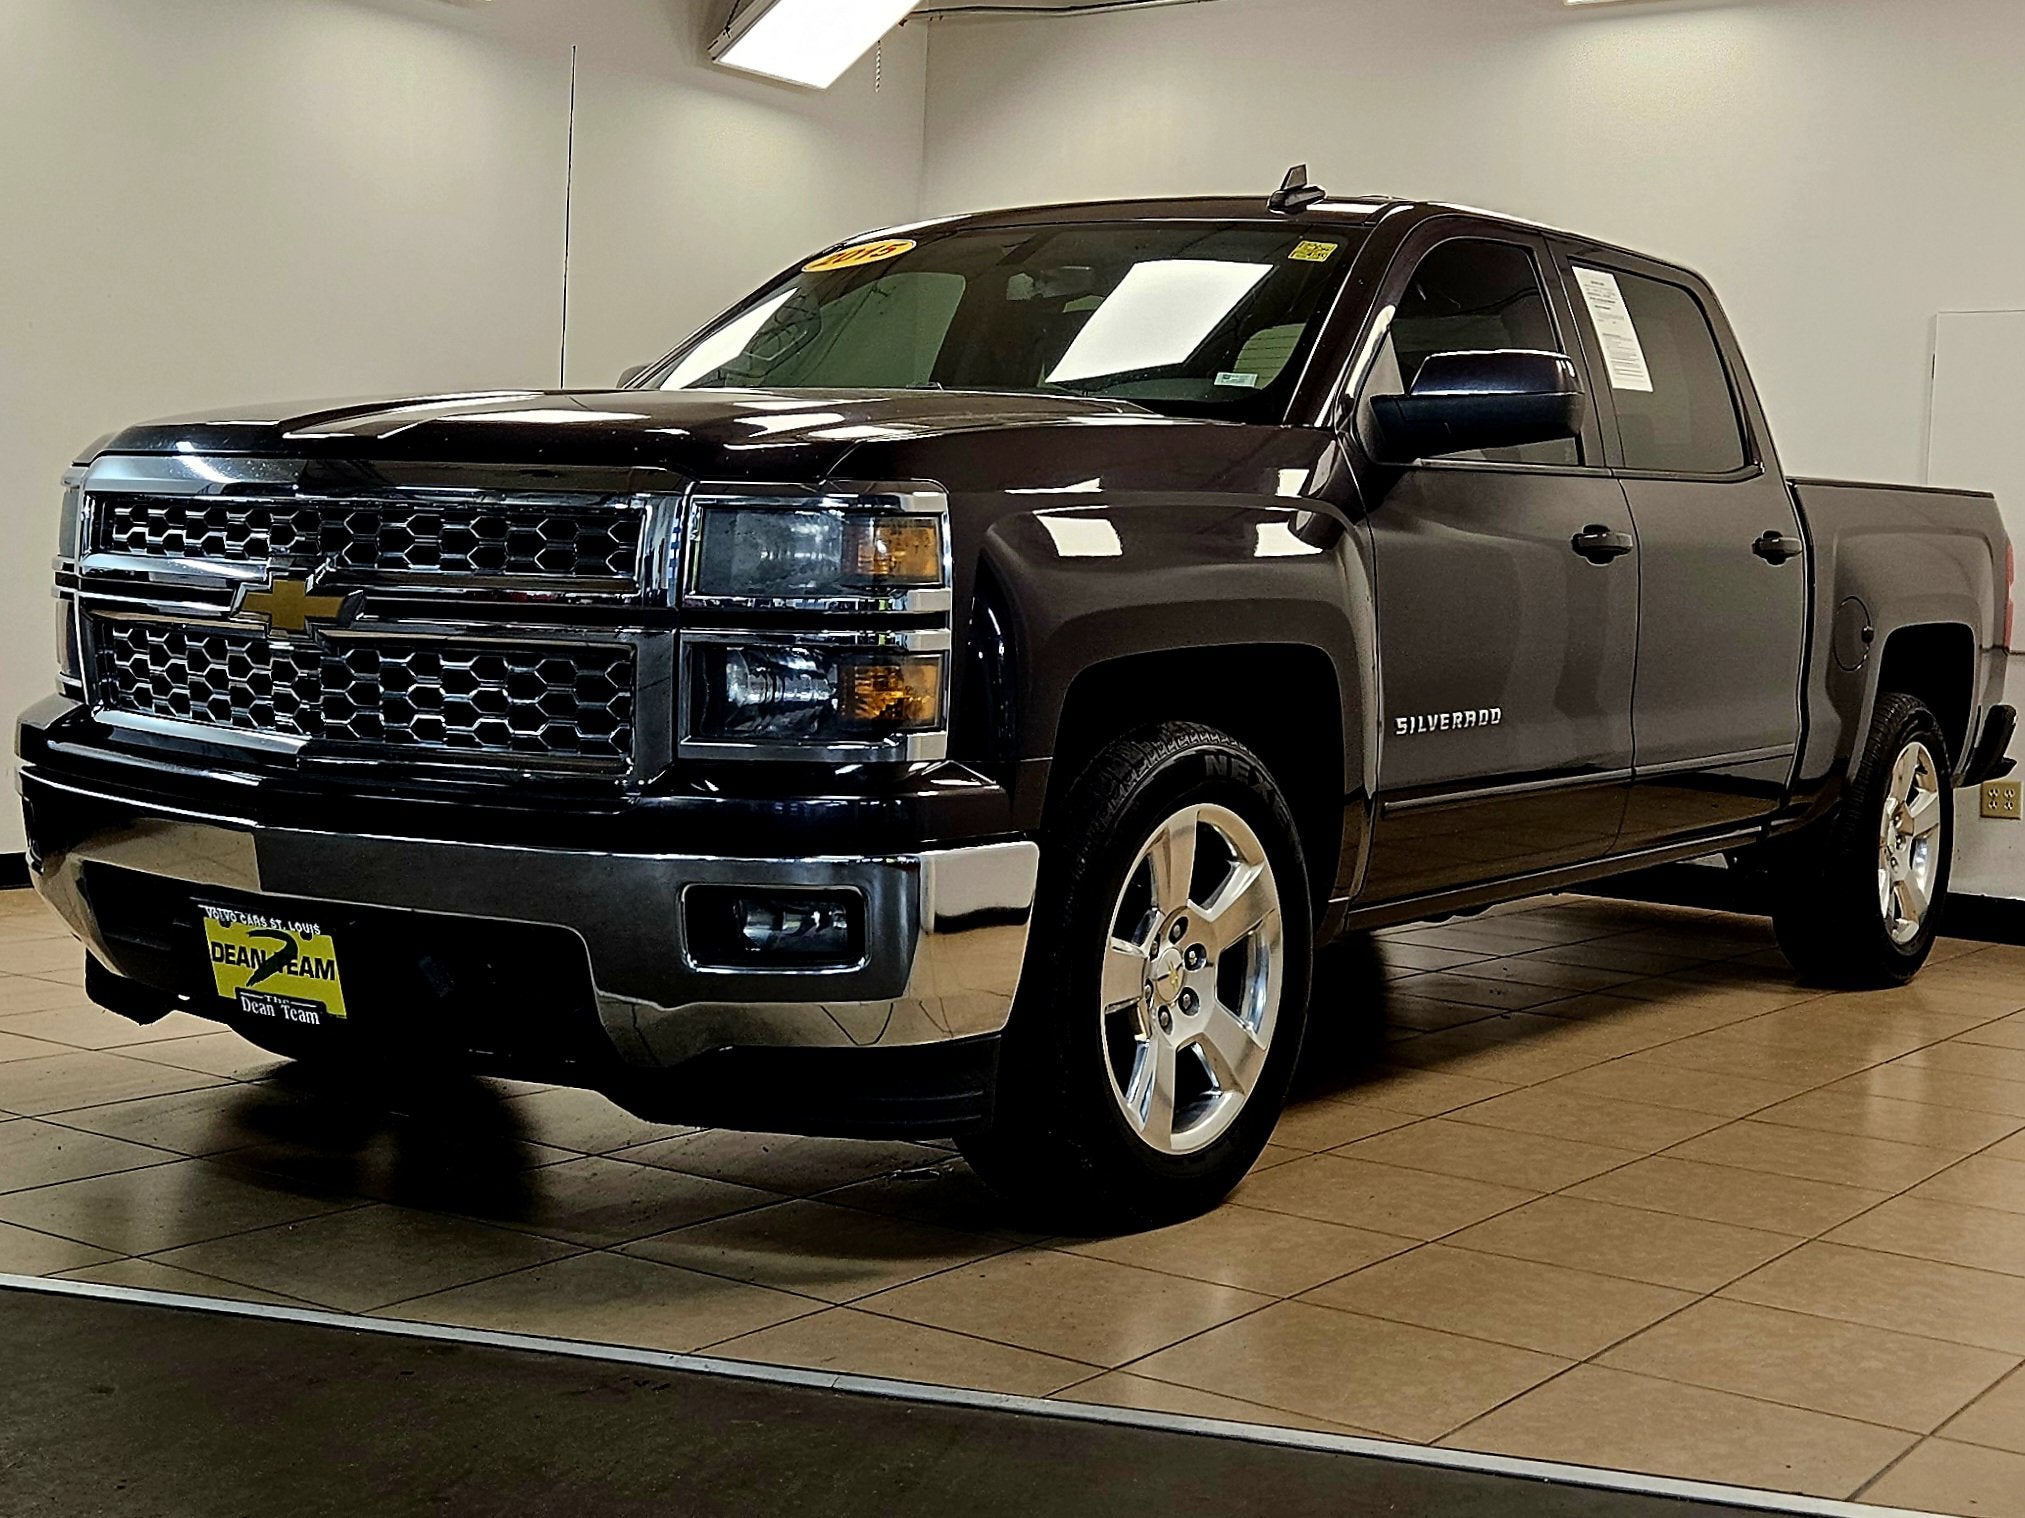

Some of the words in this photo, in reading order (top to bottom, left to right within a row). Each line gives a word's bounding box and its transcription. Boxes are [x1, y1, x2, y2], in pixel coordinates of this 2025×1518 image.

[809, 243, 908, 269] 2015
[1395, 708, 1502, 735] SILVERADO
[205, 907, 238, 923] VOLVO
[239, 913, 267, 928] CARS
[269, 918, 287, 931] ST.
[288, 921, 321, 935] LOUIS
[210, 941, 268, 969] DEAN
[277, 953, 335, 981] EAM
[240, 996, 276, 1017] Dean
[281, 1005, 321, 1025] Team
[264, 994, 290, 1004] The
